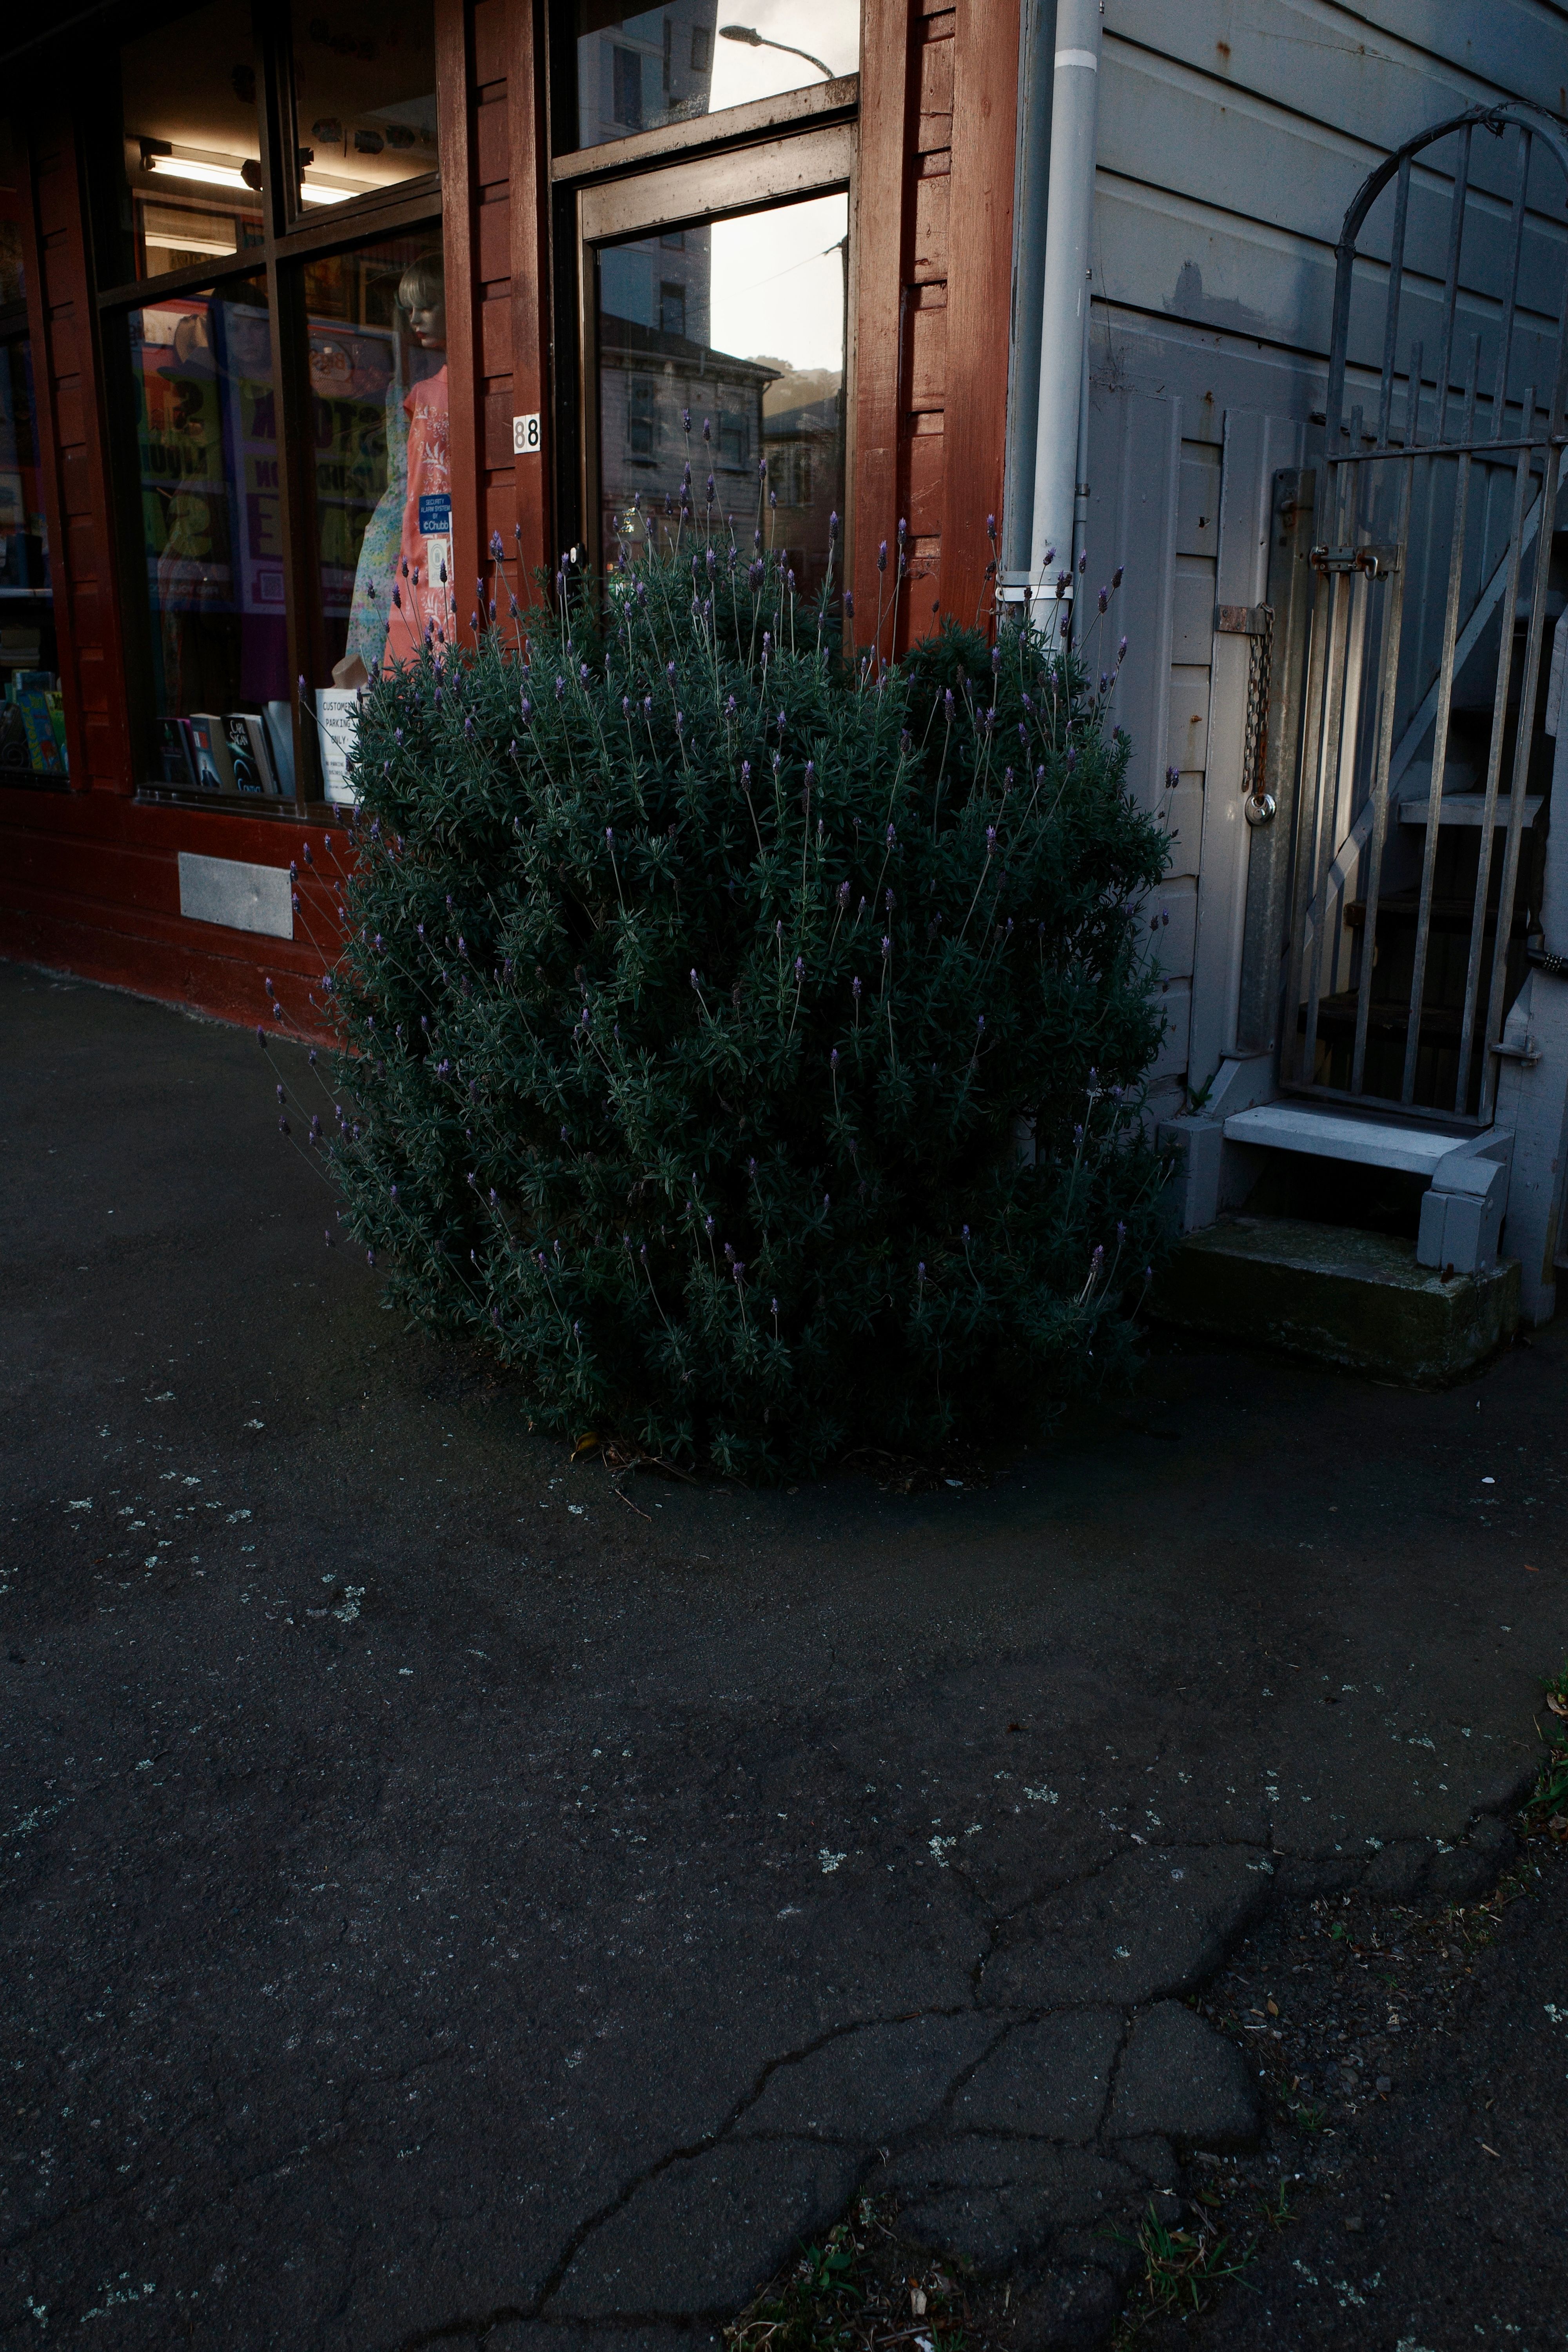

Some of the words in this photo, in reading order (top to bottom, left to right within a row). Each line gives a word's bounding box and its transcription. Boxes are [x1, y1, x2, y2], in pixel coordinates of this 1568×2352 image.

[515, 419, 538, 448] 88
[429, 520, 449, 530] Chubb
[323, 702, 352, 710] CUSTOMER
[326, 719, 350, 728] PARKING
